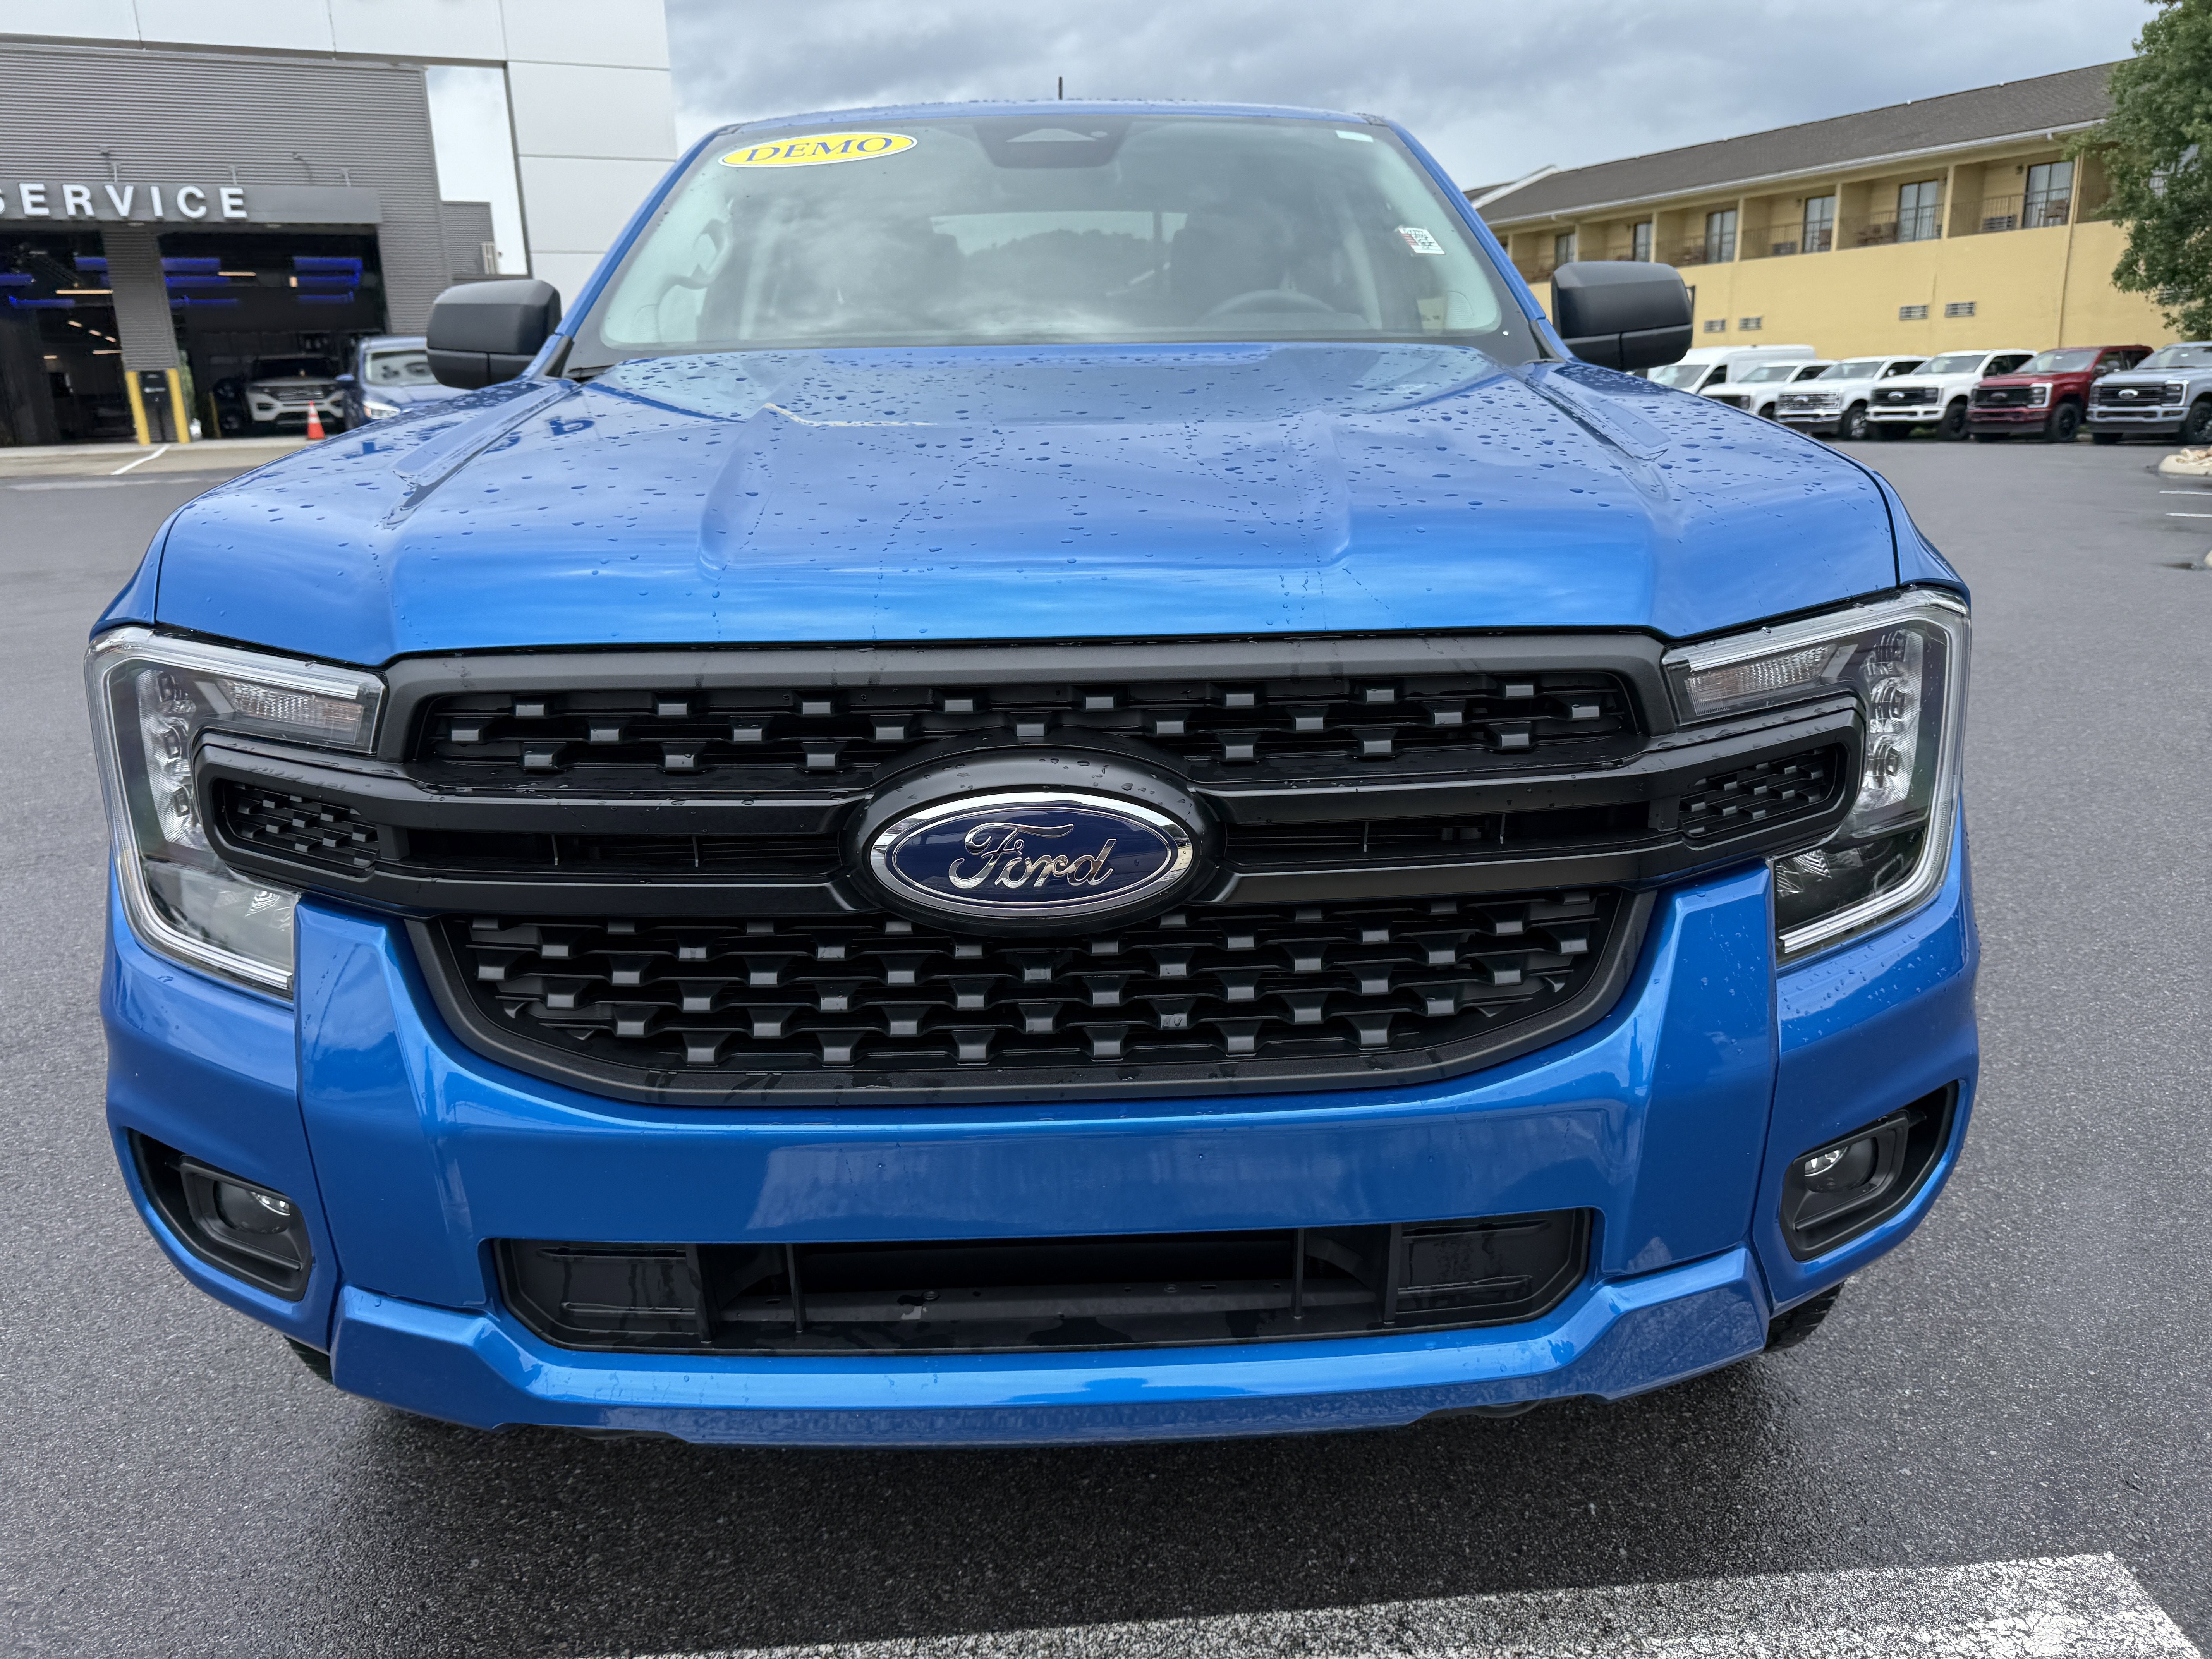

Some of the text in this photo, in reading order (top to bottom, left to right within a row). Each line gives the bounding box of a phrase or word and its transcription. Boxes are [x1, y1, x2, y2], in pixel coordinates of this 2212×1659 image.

[745, 137, 893, 162] DEMO
[0, 183, 247, 218] ERVICE
[948, 822, 1117, 889] Ford
